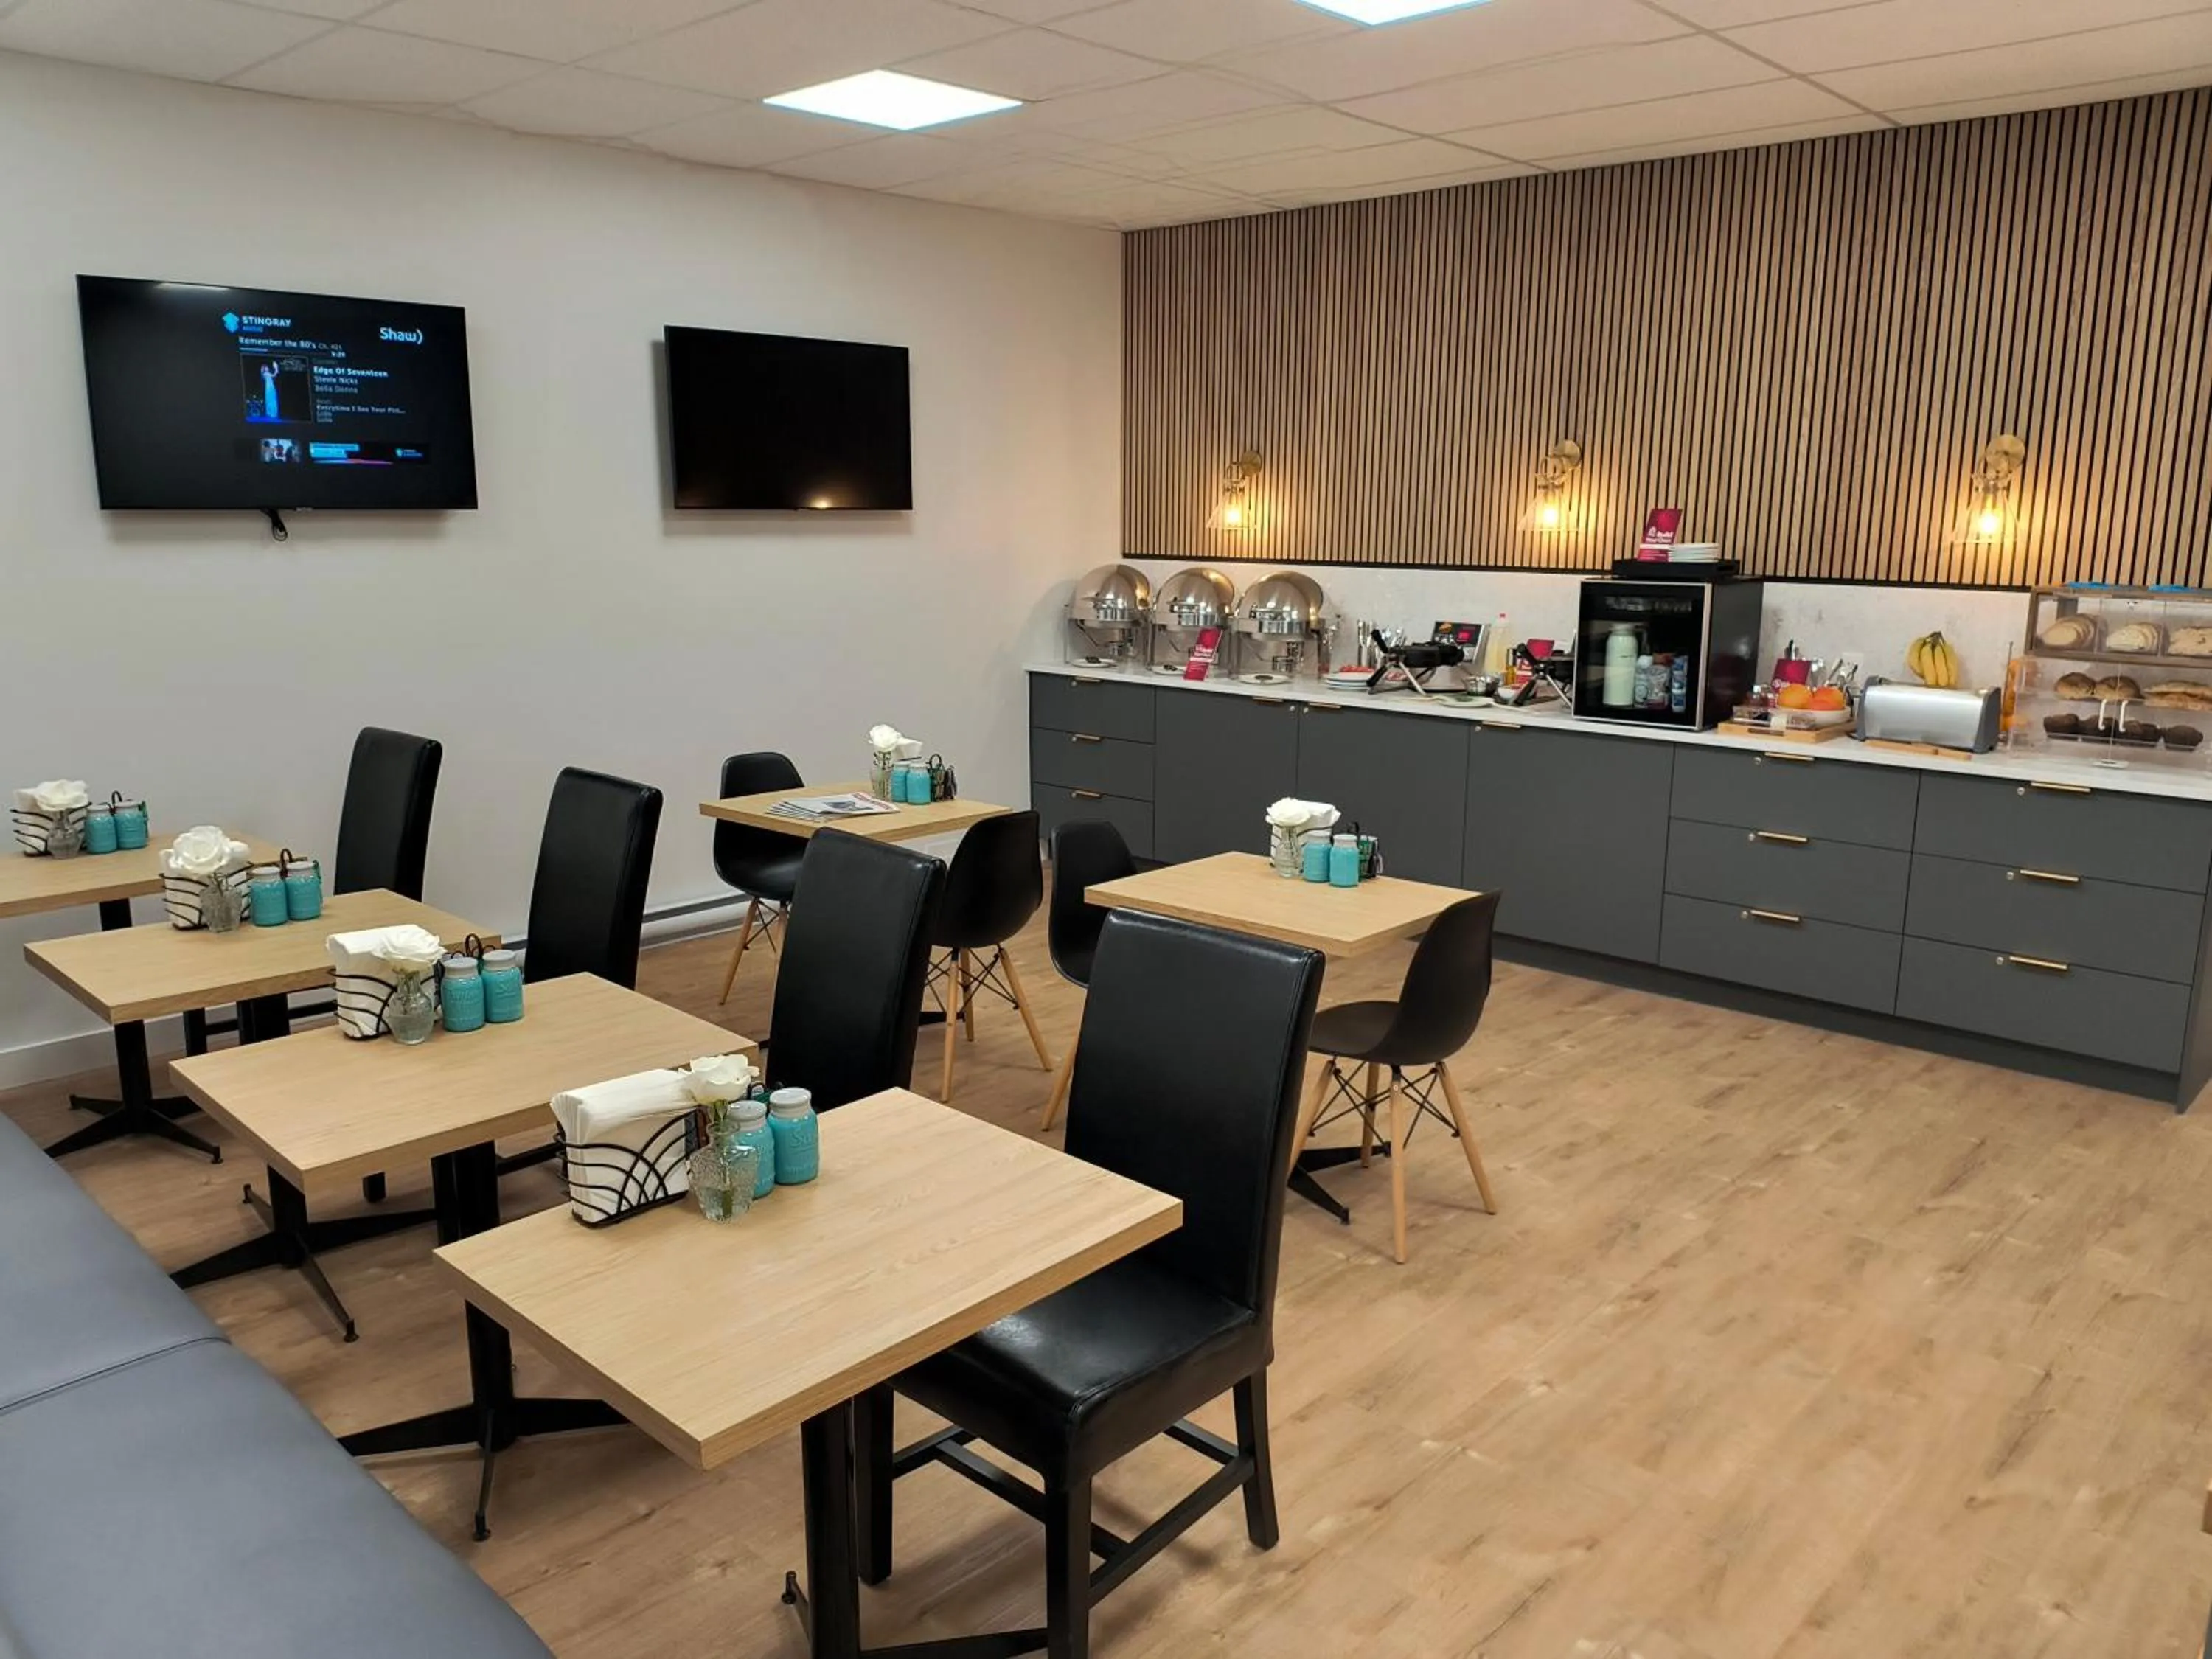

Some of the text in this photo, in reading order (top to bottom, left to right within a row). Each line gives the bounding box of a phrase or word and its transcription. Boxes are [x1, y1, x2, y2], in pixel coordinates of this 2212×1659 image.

[242, 316, 291, 327] STINGRAY
[238, 336, 282, 347] Remember
[284, 339, 297, 348] the
[313, 366, 333, 375] Edge
[347, 368, 389, 378] Seventeen
[338, 377, 358, 385] Nicks
